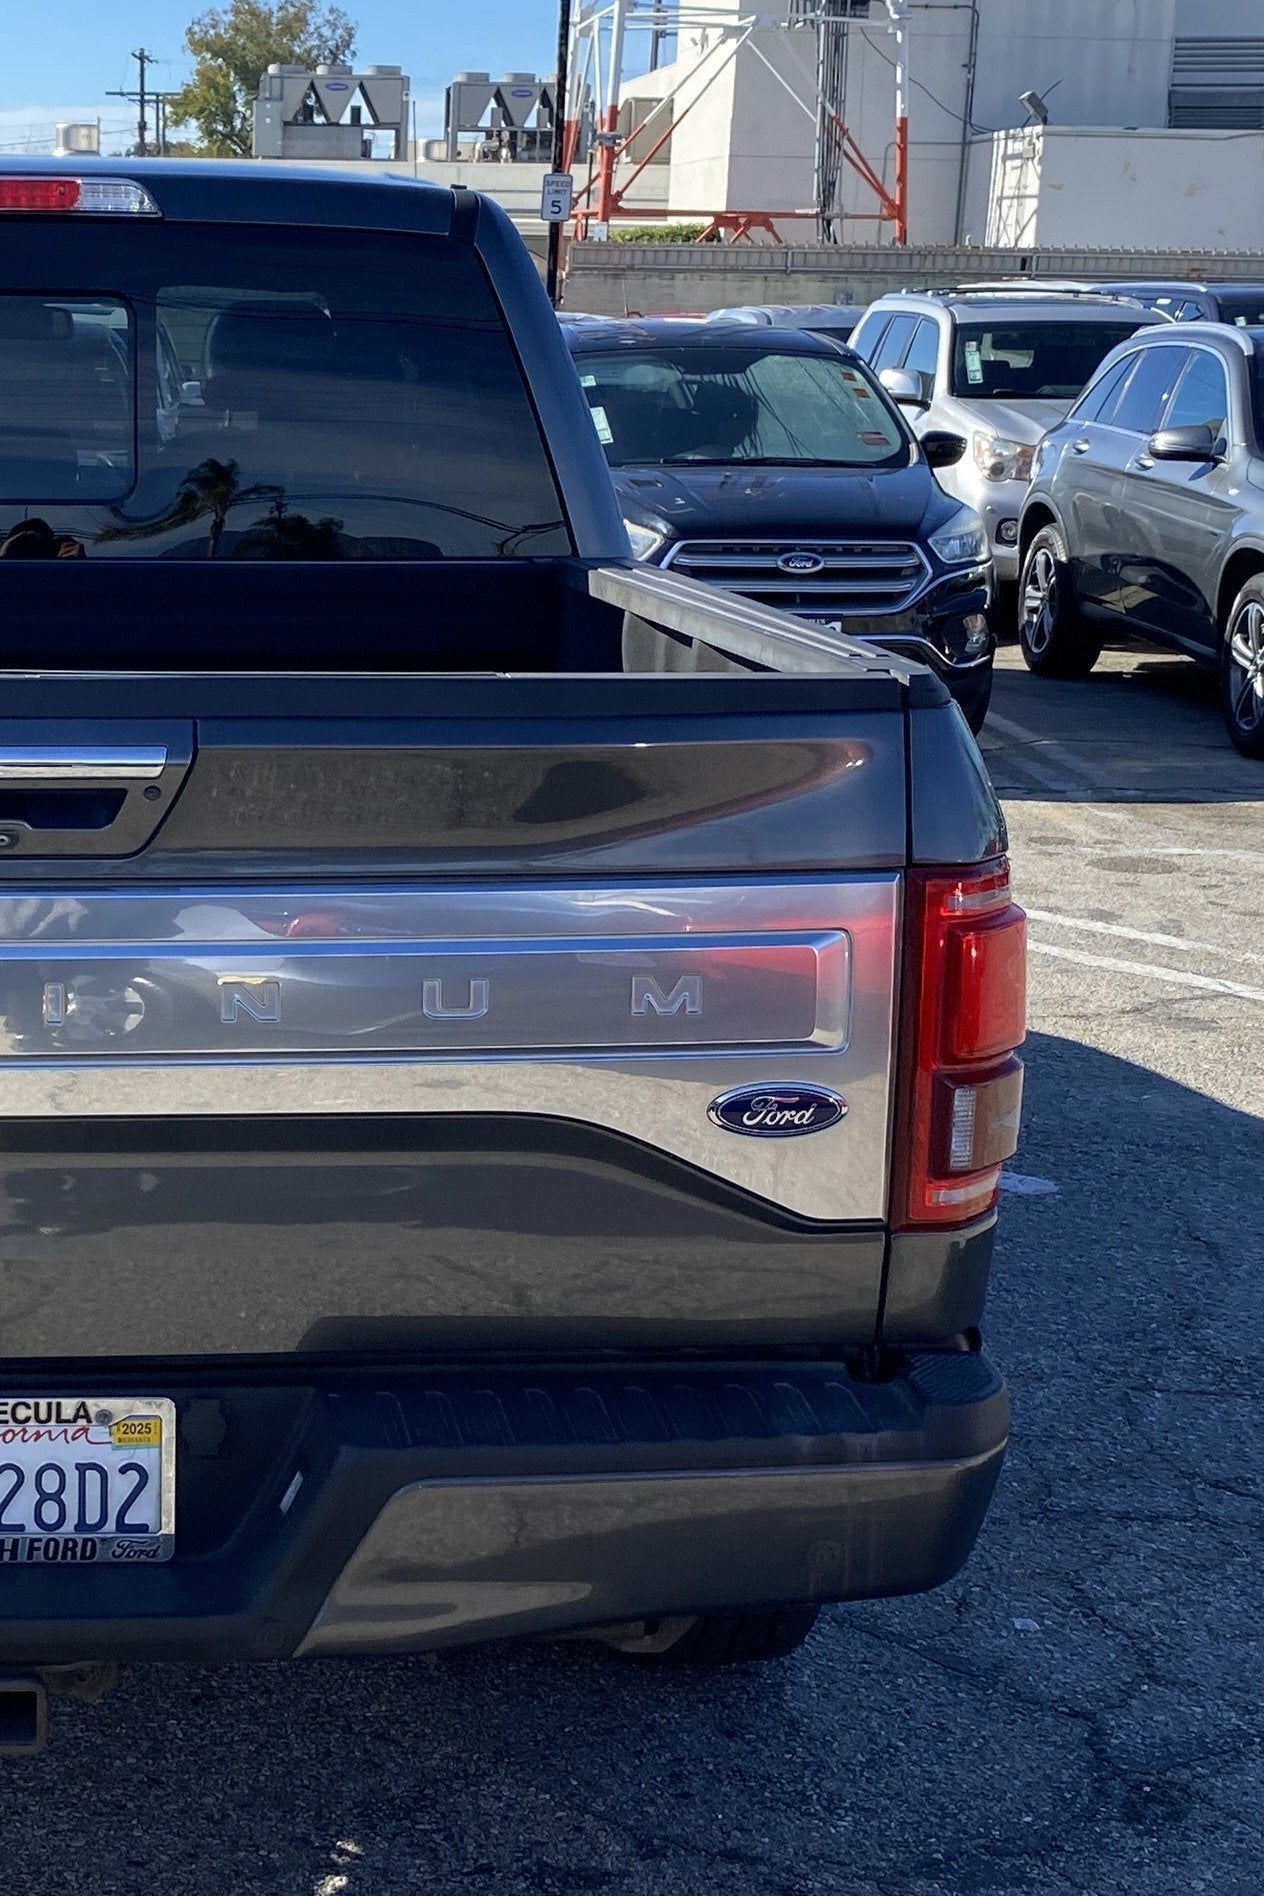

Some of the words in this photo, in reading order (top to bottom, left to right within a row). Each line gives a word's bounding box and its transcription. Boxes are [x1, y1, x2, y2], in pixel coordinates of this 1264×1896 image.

[550, 200, 562, 214] 5
[742, 1095, 818, 1125] Ford
[122, 1422, 152, 1435] 2025
[26, 1537, 97, 1562] FORD
[111, 1539, 161, 1560] Ford
